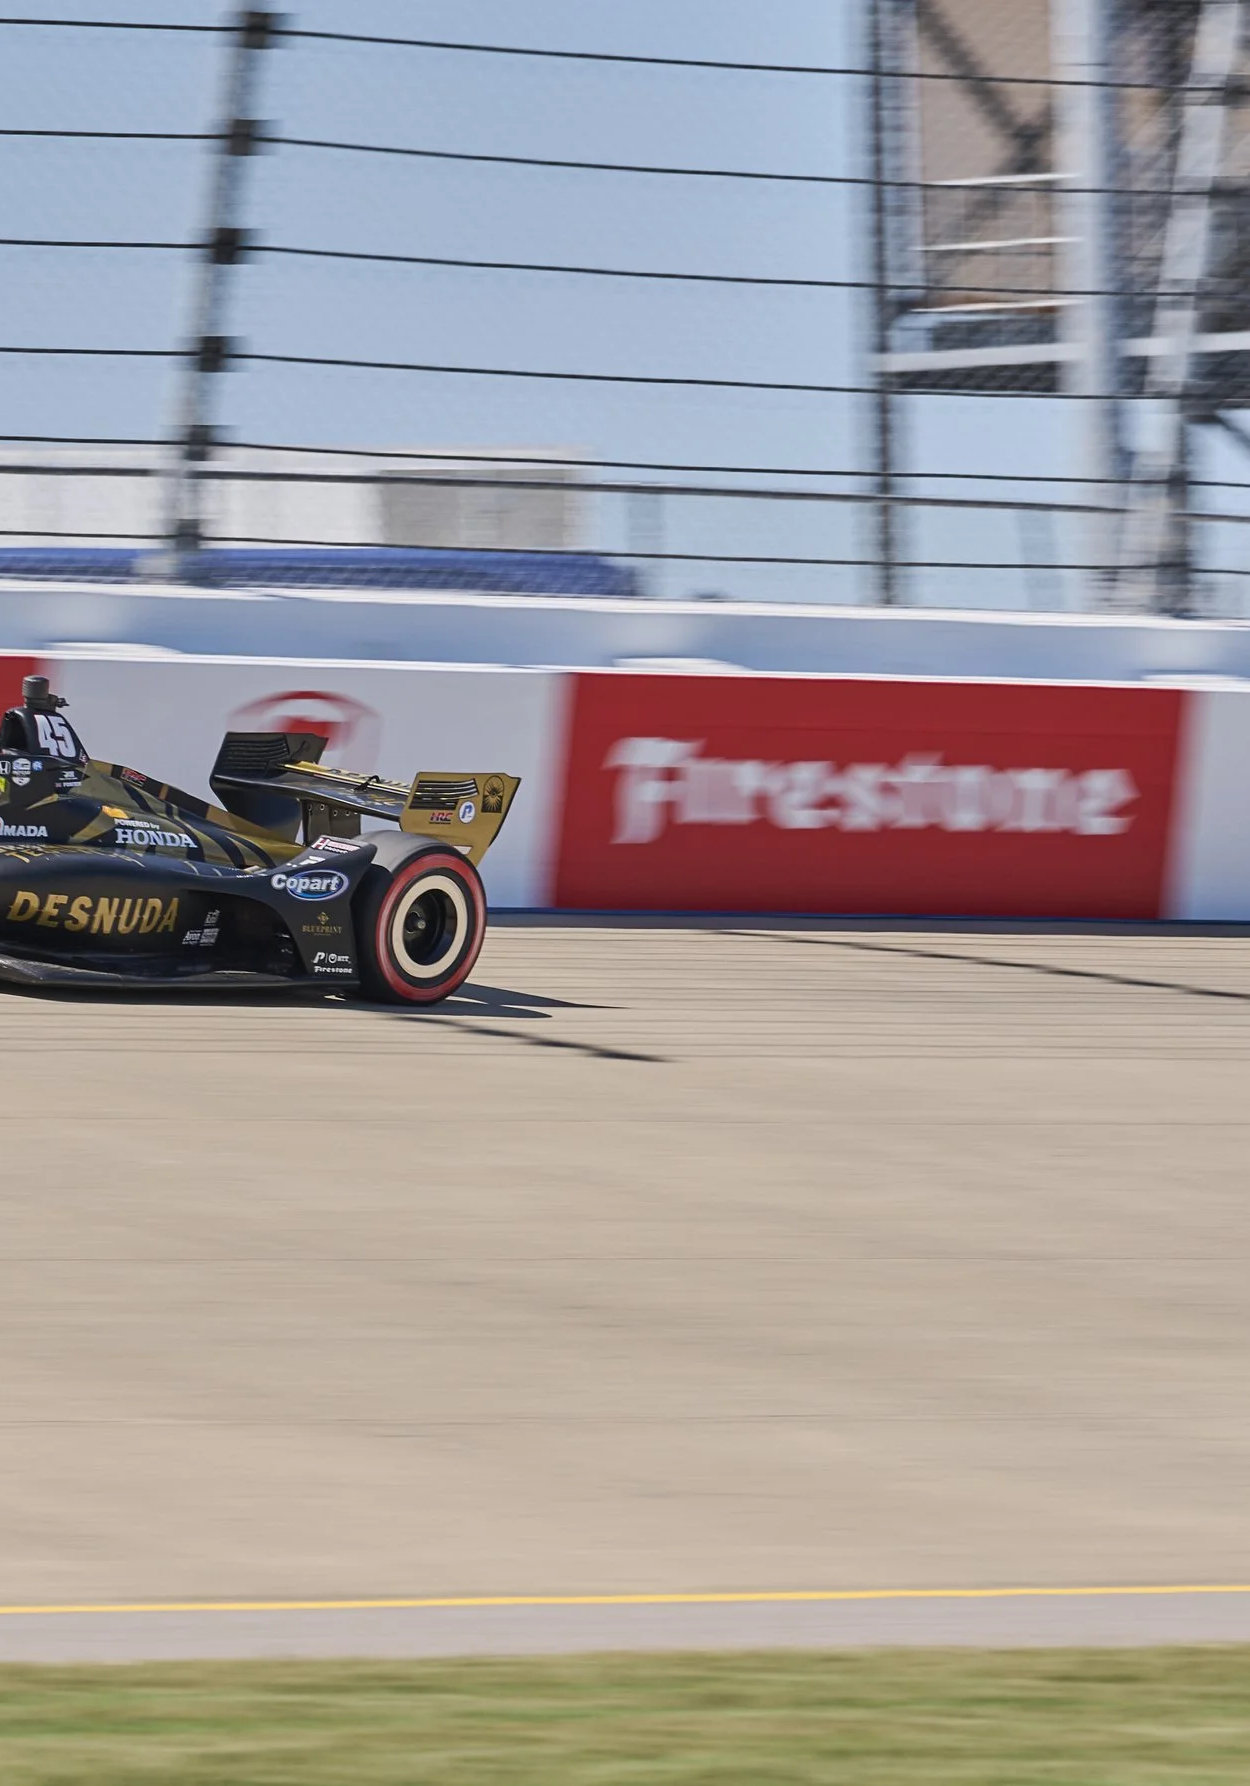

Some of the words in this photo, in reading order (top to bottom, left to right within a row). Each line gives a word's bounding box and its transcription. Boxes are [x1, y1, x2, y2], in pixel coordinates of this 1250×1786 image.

[33, 714, 76, 758] 45
[602, 737, 1140, 844] Firestone
[115, 828, 198, 848] HONDA
[271, 873, 341, 893] Copart
[6, 890, 179, 935] DESNUDA
[314, 965, 353, 974] Firestone
